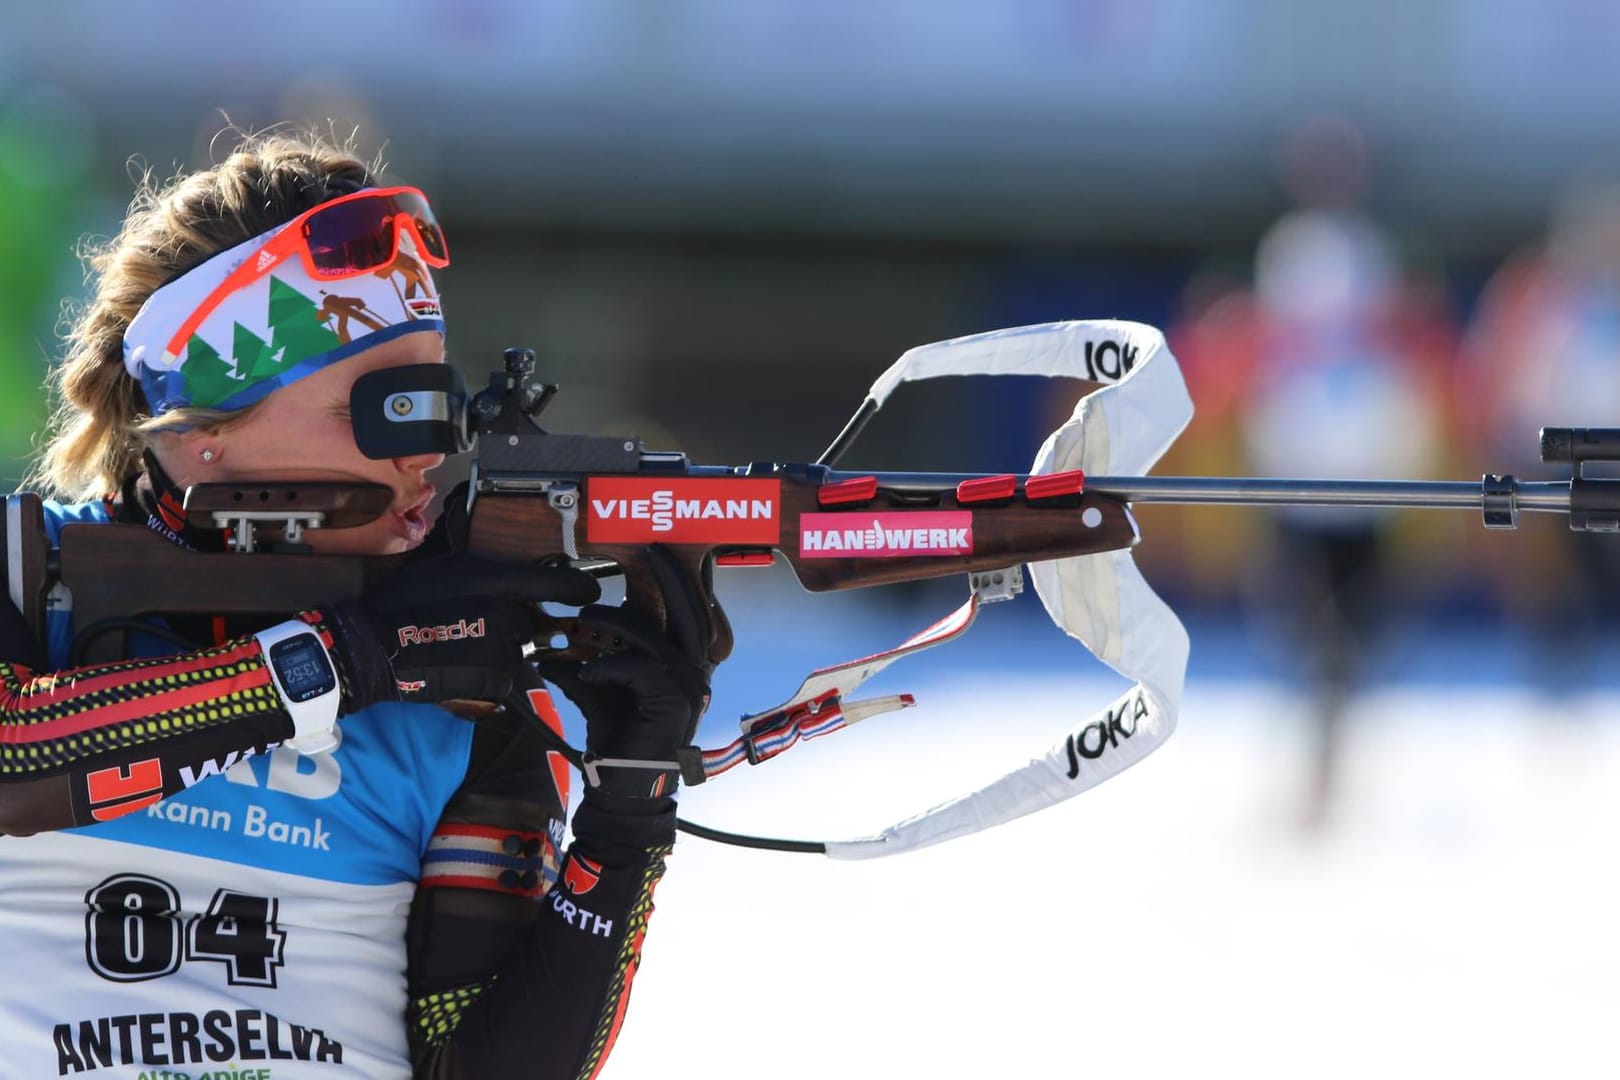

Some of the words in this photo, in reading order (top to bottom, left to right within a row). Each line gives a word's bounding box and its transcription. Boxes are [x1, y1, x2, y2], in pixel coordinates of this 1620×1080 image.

[593, 490, 772, 532] VIESSMANN
[1066, 690, 1149, 780] JOKA
[243, 804, 331, 851] Bank
[84, 873, 288, 989] 84
[53, 1009, 343, 1076] ANTERSELVA
